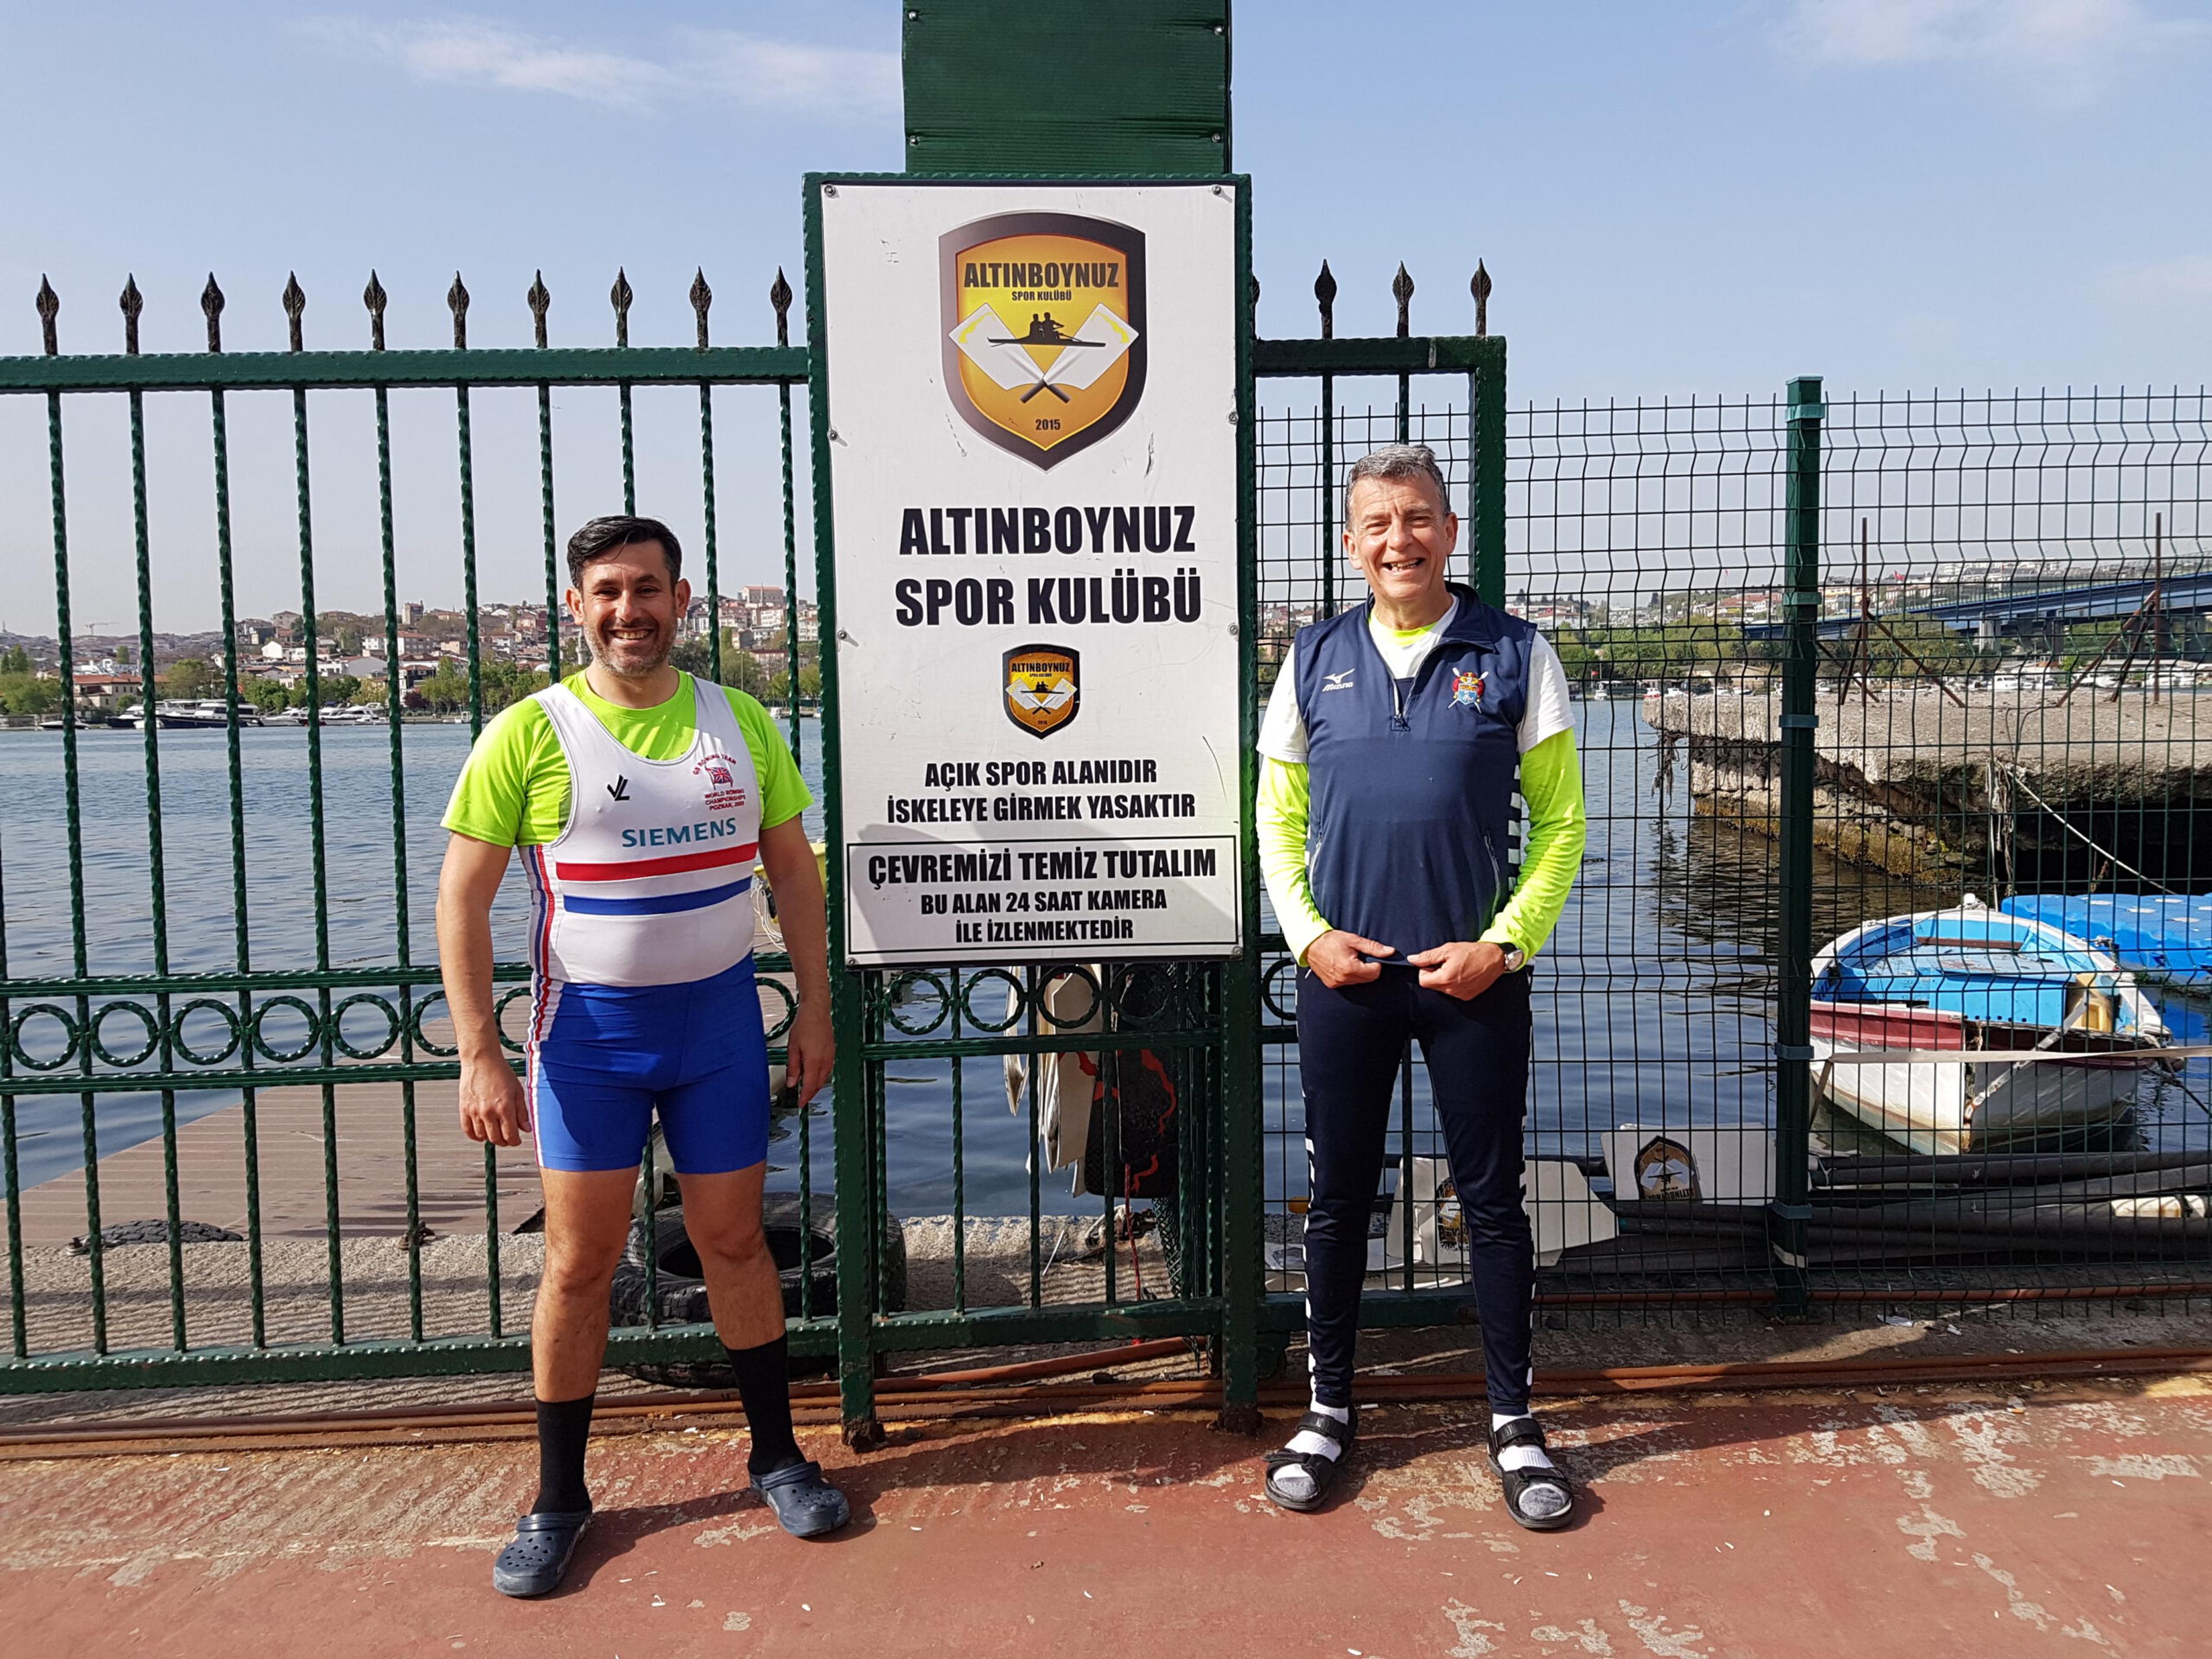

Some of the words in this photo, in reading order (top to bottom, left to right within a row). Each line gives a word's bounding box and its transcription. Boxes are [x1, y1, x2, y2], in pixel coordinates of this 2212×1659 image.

[964, 262, 1119, 288] ALTINBOYNUZ
[1012, 291, 1035, 301] SPOR
[1037, 289, 1072, 301] KULÜBÜ
[1035, 419, 1061, 430] 2015
[899, 505, 1195, 555] ALTINBOYNUZ
[895, 578, 1014, 627] SPOR
[1027, 567, 1201, 624] KULÜBÜ
[1012, 663, 1070, 672] ALTINBOYNUZ
[925, 762, 981, 792] AÇIK
[986, 761, 1047, 786] SPOR
[1052, 759, 1157, 785] ALANIDIR
[887, 795, 988, 824] İSKELEYE
[993, 793, 1082, 821] GİRMEK
[1087, 794, 1195, 819] YASAKTIR
[622, 817, 737, 847] SIEMENS
[869, 847, 1012, 891] ÇEVREMİZİ
[1018, 846, 1097, 881] TEMİZ
[1103, 849, 1216, 878] TUTALIM
[921, 894, 948, 915] BU
[953, 893, 1001, 914] ALAN
[1005, 892, 1031, 912] 24
[1034, 891, 1083, 912] SAAT
[1088, 889, 1167, 911] KAMERA
[956, 919, 983, 943] İLE
[987, 915, 1134, 942] İZLENMEKTEDİR
